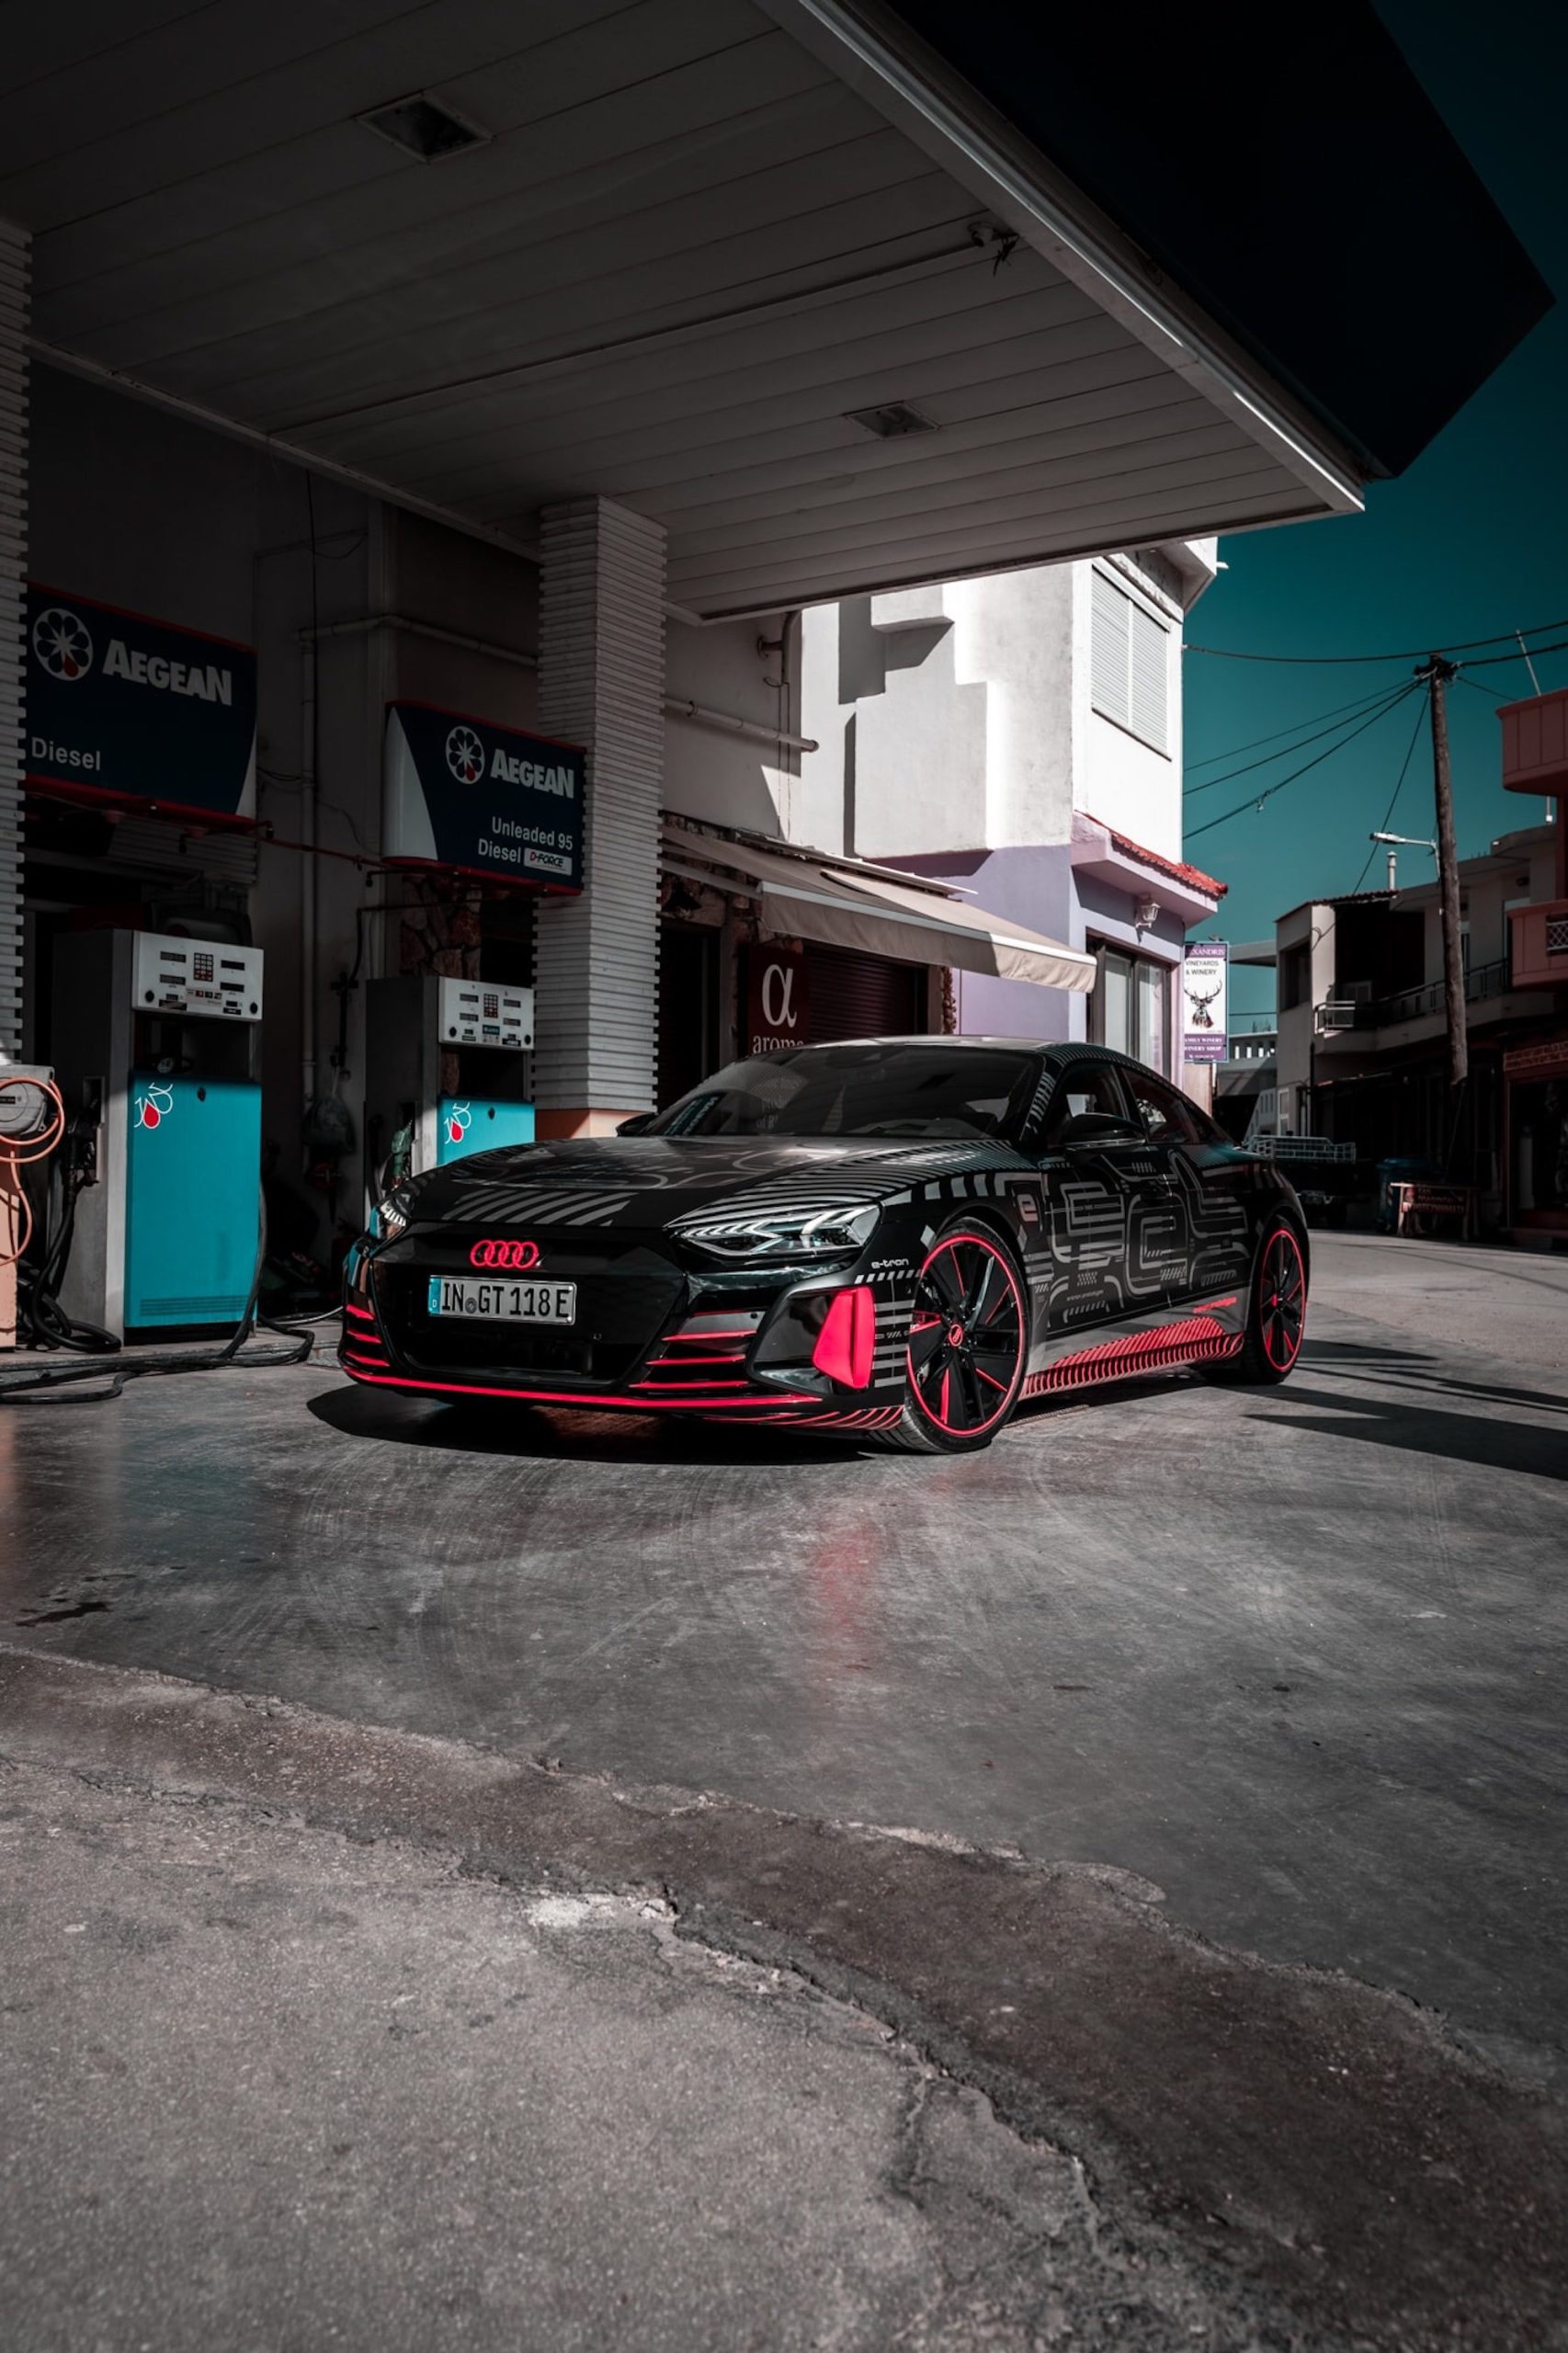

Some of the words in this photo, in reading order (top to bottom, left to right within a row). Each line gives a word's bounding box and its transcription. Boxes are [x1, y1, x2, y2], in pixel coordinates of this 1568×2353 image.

[101, 639, 233, 706] AEGEAN
[31, 736, 101, 771] Diesel
[490, 748, 574, 800] AEGEAN
[478, 838, 521, 863] Diesel
[492, 816, 554, 847] Unleaded
[557, 833, 574, 851] 95
[870, 1257, 909, 1269] e-tron
[442, 1283, 464, 1312] IN
[478, 1285, 505, 1314] GT
